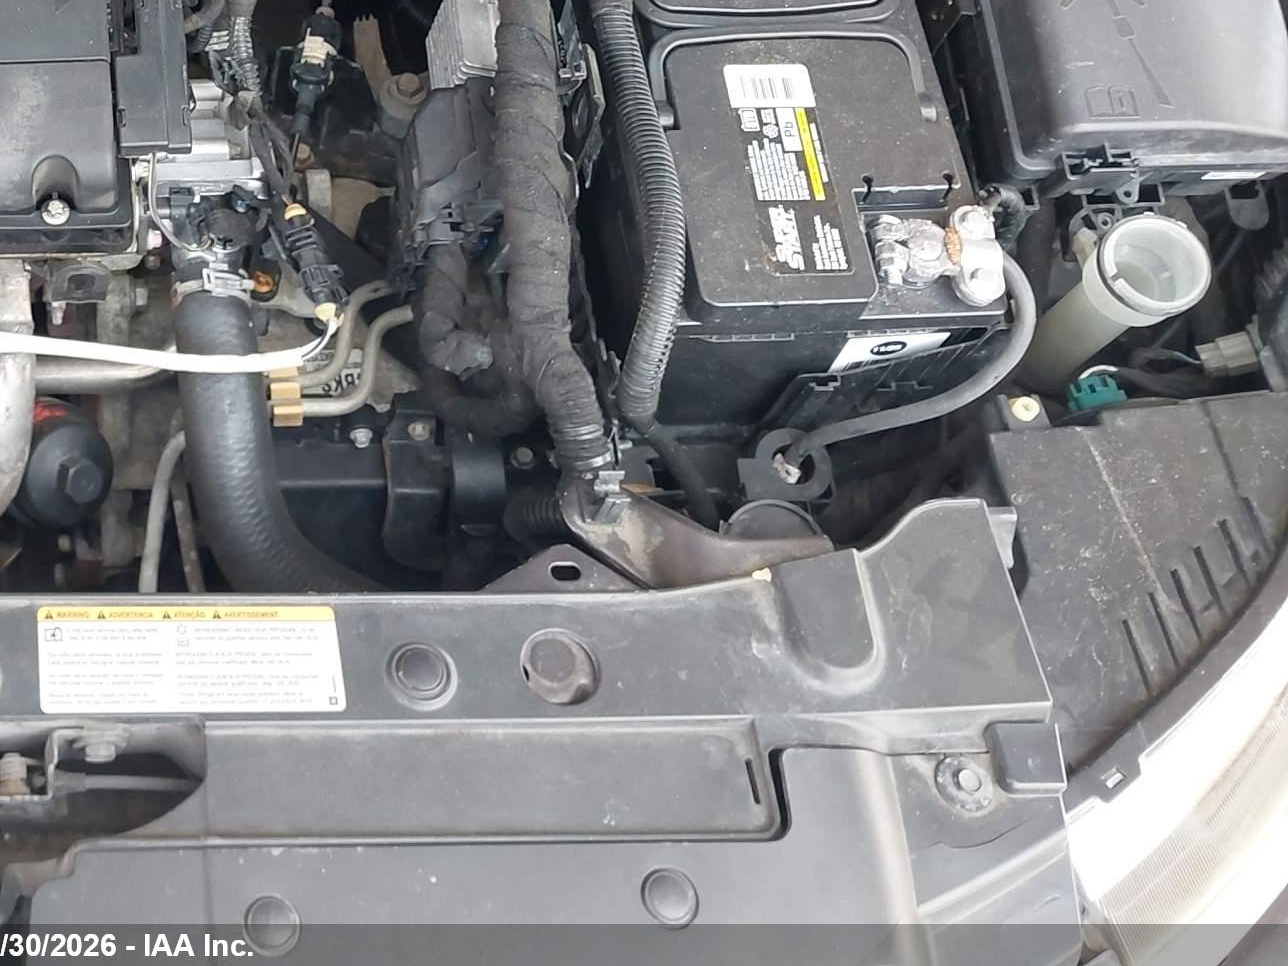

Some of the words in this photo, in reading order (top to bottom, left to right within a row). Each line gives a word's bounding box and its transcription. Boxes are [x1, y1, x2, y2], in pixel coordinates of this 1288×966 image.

[785, 121, 795, 137] Pb
[56, 611, 89, 619] WARNING
[108, 610, 153, 619] ADVERTENCIA
[224, 610, 278, 619] AVERTISSEMENT
